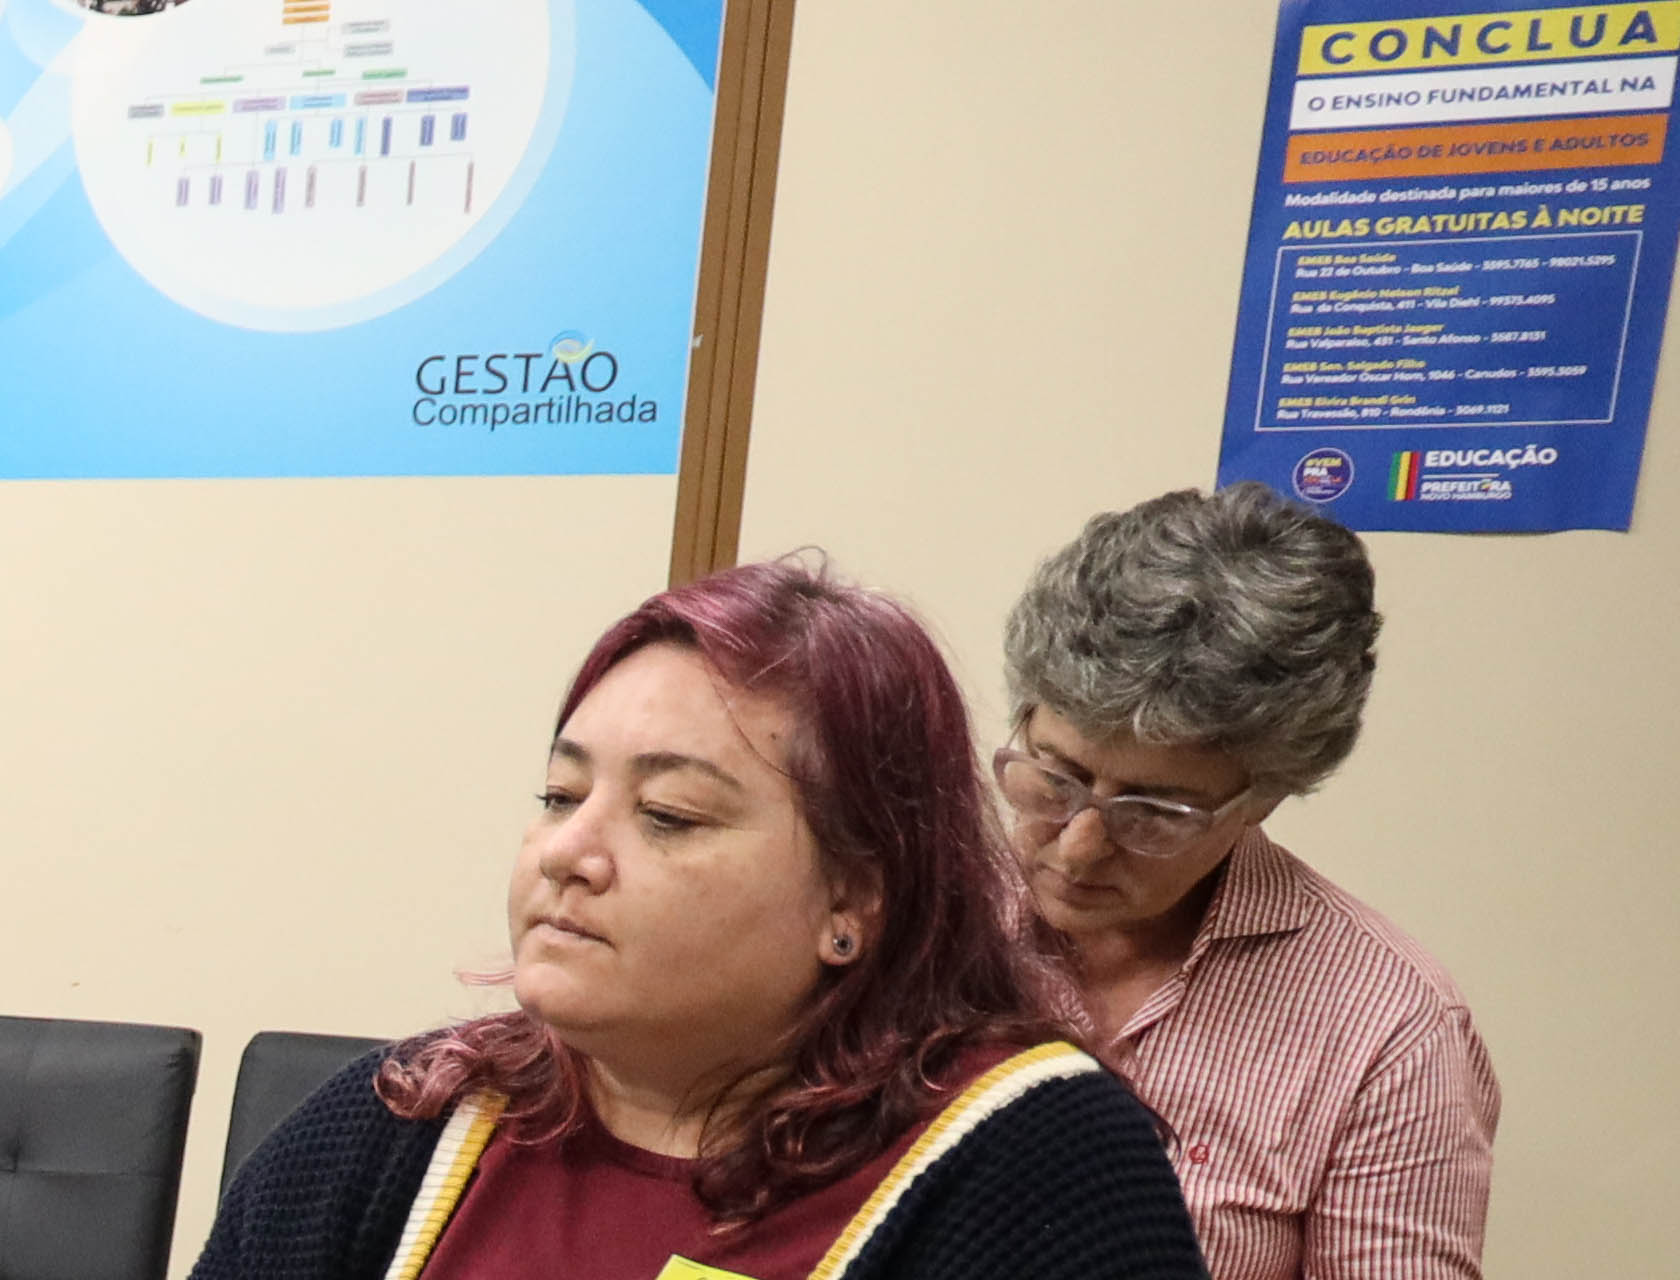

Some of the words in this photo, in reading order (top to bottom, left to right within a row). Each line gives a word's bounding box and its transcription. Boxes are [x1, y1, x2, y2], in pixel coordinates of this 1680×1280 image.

[1320, 10, 1659, 66] CONCLUA
[1307, 98, 1326, 112] O
[1332, 90, 1420, 110] ENSINO
[1426, 79, 1613, 105] FUNDAMENTAL
[1619, 76, 1657, 92] NA
[1299, 145, 1410, 166] EDUCAÇÃO
[1418, 144, 1442, 159] DE
[1447, 139, 1528, 158] JOVENS
[1533, 138, 1545, 152] E
[1549, 132, 1650, 151] ADULTOS
[1284, 189, 1376, 208] Modalidade
[1380, 186, 1457, 203] destinada
[1460, 187, 1496, 204] para
[1498, 180, 1563, 198] maiores
[1566, 178, 1587, 193] de
[1590, 177, 1608, 191] 15
[1611, 176, 1651, 190] anos
[1282, 217, 1371, 241] AULAS
[1375, 209, 1528, 237] GRATUITAS
[1532, 204, 1554, 229] À
[1557, 204, 1646, 227] NOITE
[1295, 267, 1319, 279] Rua
[1335, 266, 1351, 277] de
[1352, 264, 1402, 276] Outubro
[1290, 303, 1314, 314] Rua
[1285, 339, 1310, 350] Rua
[1280, 374, 1305, 385] Rua
[1464, 368, 1518, 380] Canudos
[413, 394, 657, 432] Compartilhada
[1276, 409, 1301, 420] Rua
[1424, 444, 1558, 470] EDUCAÇÃO
